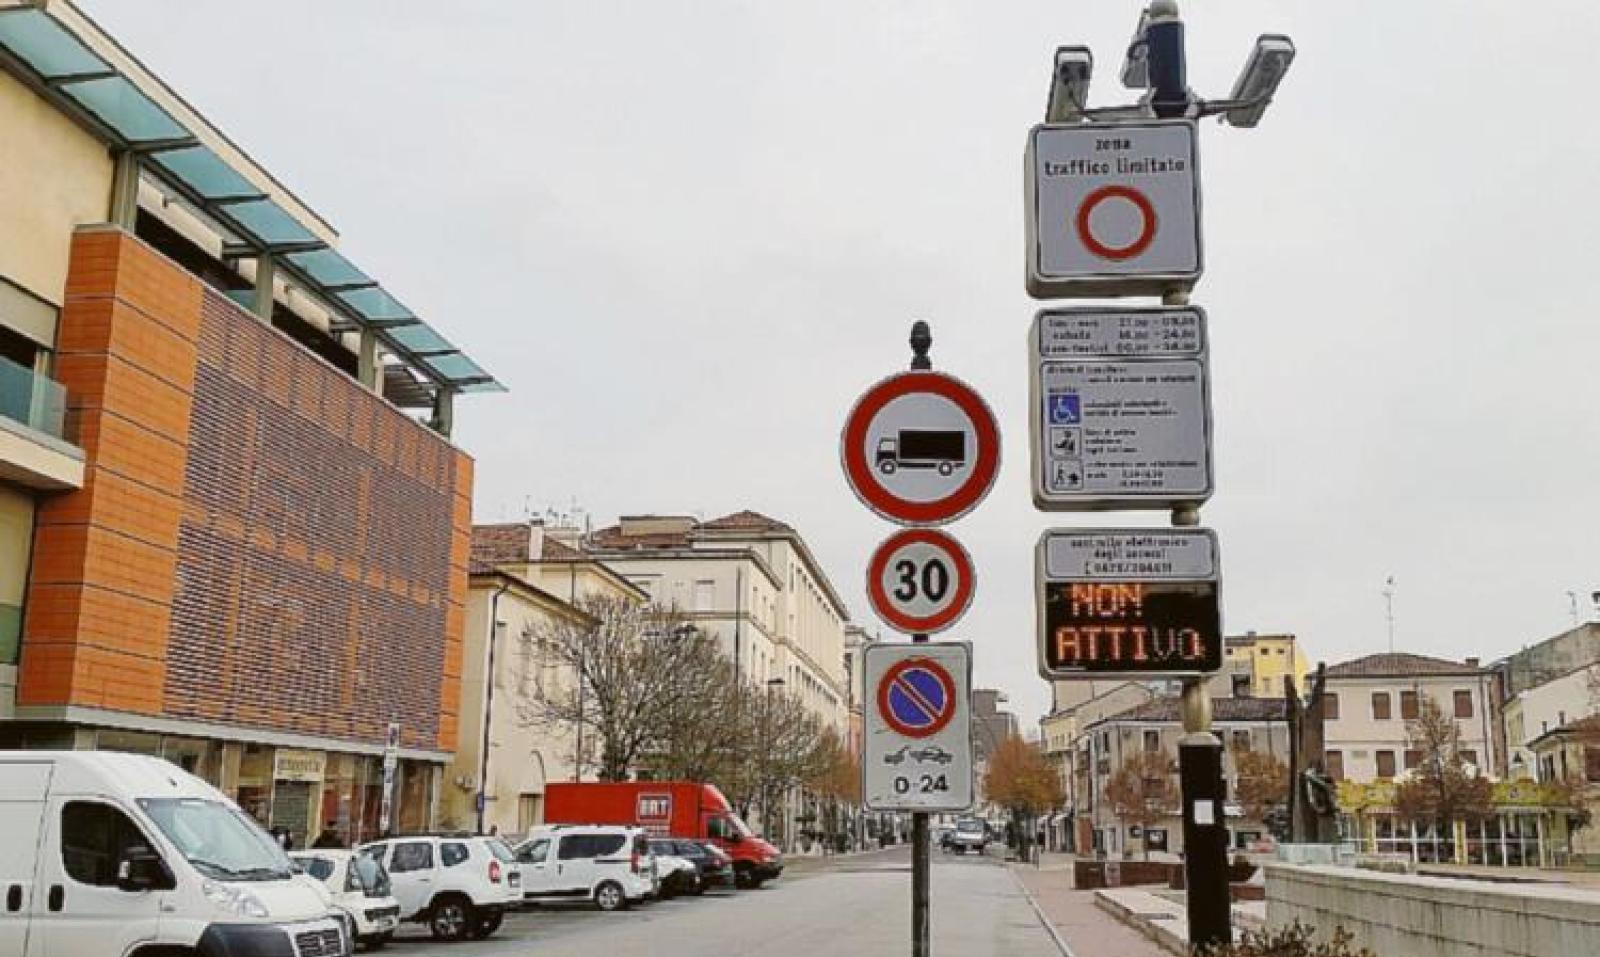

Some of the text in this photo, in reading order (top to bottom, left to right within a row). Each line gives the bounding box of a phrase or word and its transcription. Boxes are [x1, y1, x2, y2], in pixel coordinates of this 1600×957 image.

[1096, 139, 1131, 150] zona
[1045, 157, 1185, 175] traffico limitato
[894, 558, 949, 602] 30
[1072, 583, 1142, 617] NON
[1056, 627, 1201, 660] ATTIVO
